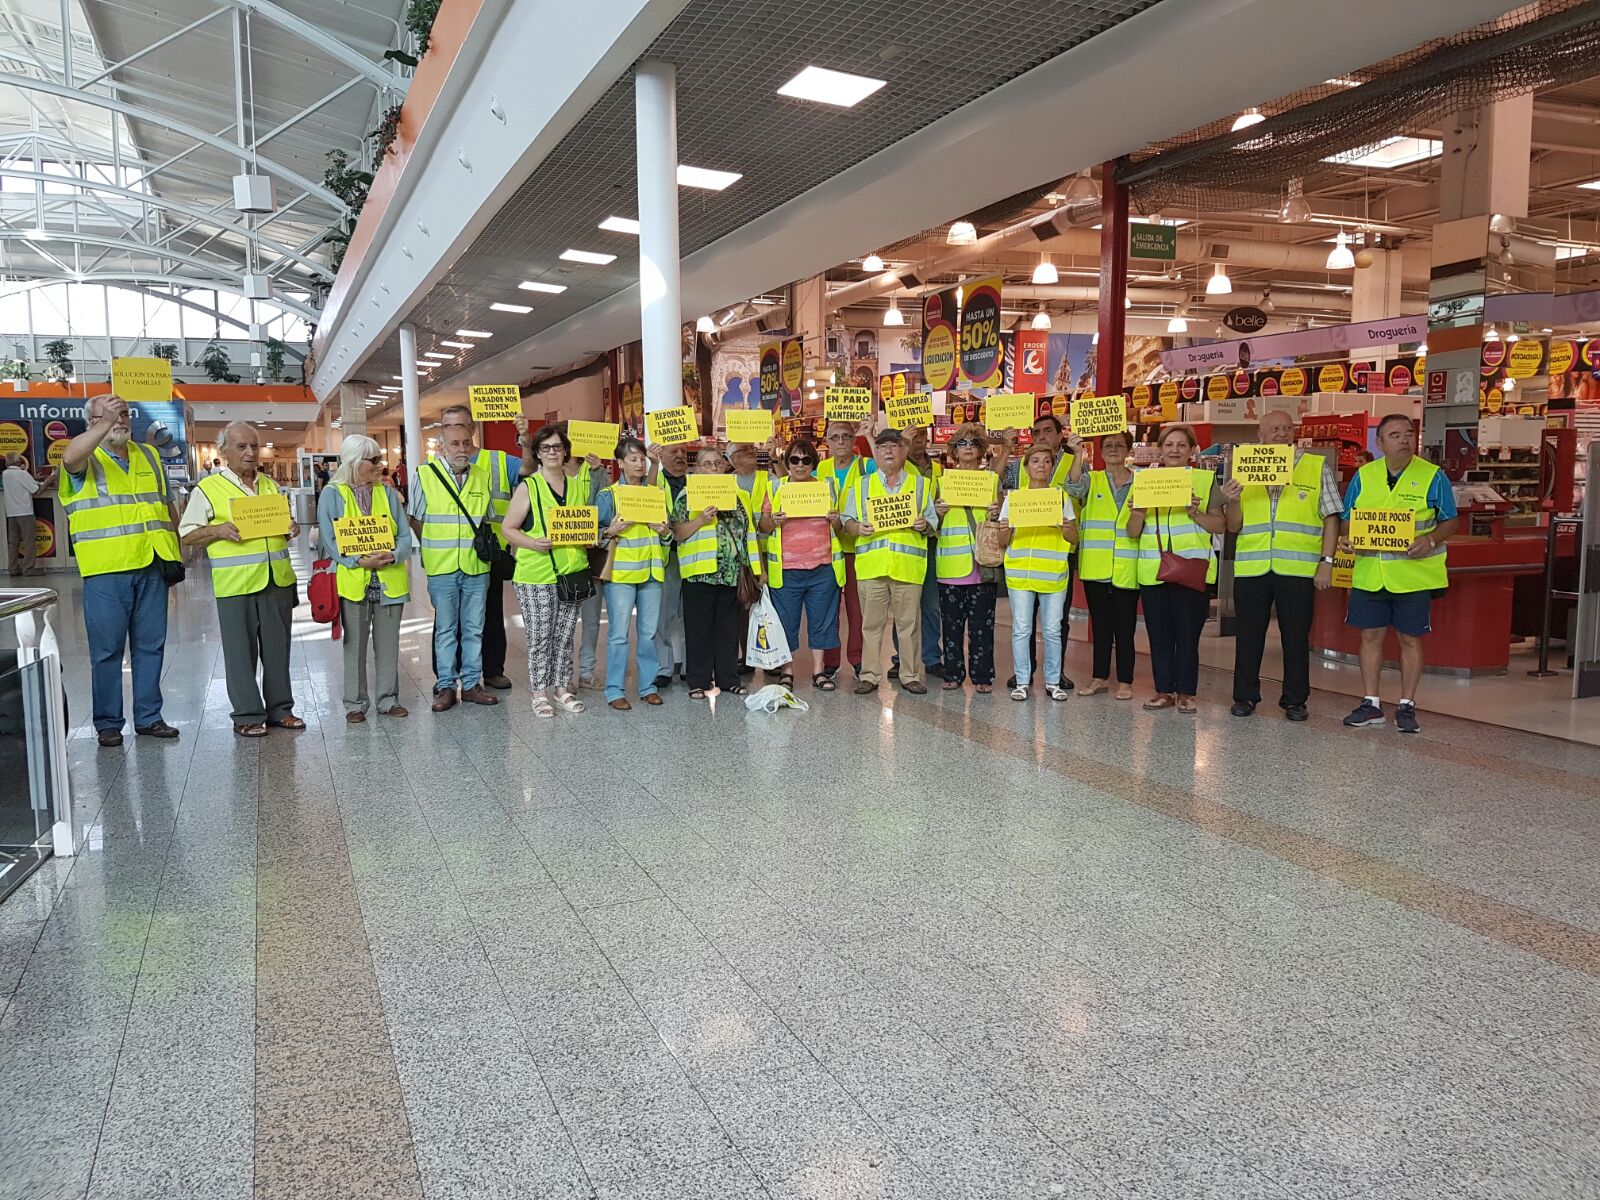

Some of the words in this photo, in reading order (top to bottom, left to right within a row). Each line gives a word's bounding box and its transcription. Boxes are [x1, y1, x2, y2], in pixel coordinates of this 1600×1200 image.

[1136, 233, 1155, 242] SALIDA
[1155, 234, 1163, 243] DE
[1136, 242, 1169, 252] EMERGENCIA
[966, 311, 984, 321] HASTA
[986, 307, 995, 316] UN
[1235, 314, 1265, 327] belle
[962, 318, 998, 352] 50%
[1368, 325, 1418, 340] Droguería
[970, 351, 994, 361] DESCUENTO
[760, 373, 780, 394] 50%
[826, 395, 839, 404] EN
[844, 395, 870, 404] PARO
[896, 395, 929, 407] DESEMPLEO
[1079, 402, 1094, 410] POR
[1095, 399, 1117, 409] CADA
[476, 411, 518, 419] INDIGNADOS
[654, 410, 686, 421] REFORMA
[890, 409, 898, 417] NO
[898, 409, 906, 417] ES
[906, 405, 930, 416] VIRTUAL
[1077, 406, 1120, 417] CONTRATO
[657, 418, 687, 429] LABORAL
[897, 419, 906, 427] ES
[907, 416, 926, 426] REAL
[1075, 417, 1089, 426] FIJO
[1090, 414, 1123, 427] ¿CUANTOS
[654, 426, 682, 437] FABRICA
[683, 424, 692, 432] DE
[1077, 423, 1121, 435] PRECARIOS?
[662, 433, 687, 443] POBRES
[1240, 456, 1287, 464] MIENTEN
[1237, 465, 1270, 473] SOBRE
[1248, 473, 1277, 481] PARO
[871, 495, 911, 506] TRABAJO
[873, 502, 910, 514] ESTABLE
[556, 510, 591, 518] PARADOS
[873, 509, 912, 522] SALARIO
[1354, 511, 1377, 520] LUCRO
[1379, 512, 1388, 520] DE
[1389, 512, 1411, 521] POCOS
[358, 518, 377, 527] MAS
[552, 521, 563, 529] SIN
[565, 520, 594, 529] SUBSIDIO
[879, 517, 909, 529] DIGNO
[339, 526, 388, 537] PRECARIEDAD
[1368, 524, 1396, 534] PARO
[357, 535, 375, 544] MAS
[550, 533, 558, 542] ES
[560, 532, 595, 542] HOMICIDIO
[1353, 536, 1365, 545] DE
[1370, 537, 1410, 548] MUCHOS
[342, 542, 392, 554] DESIGUALDAD
